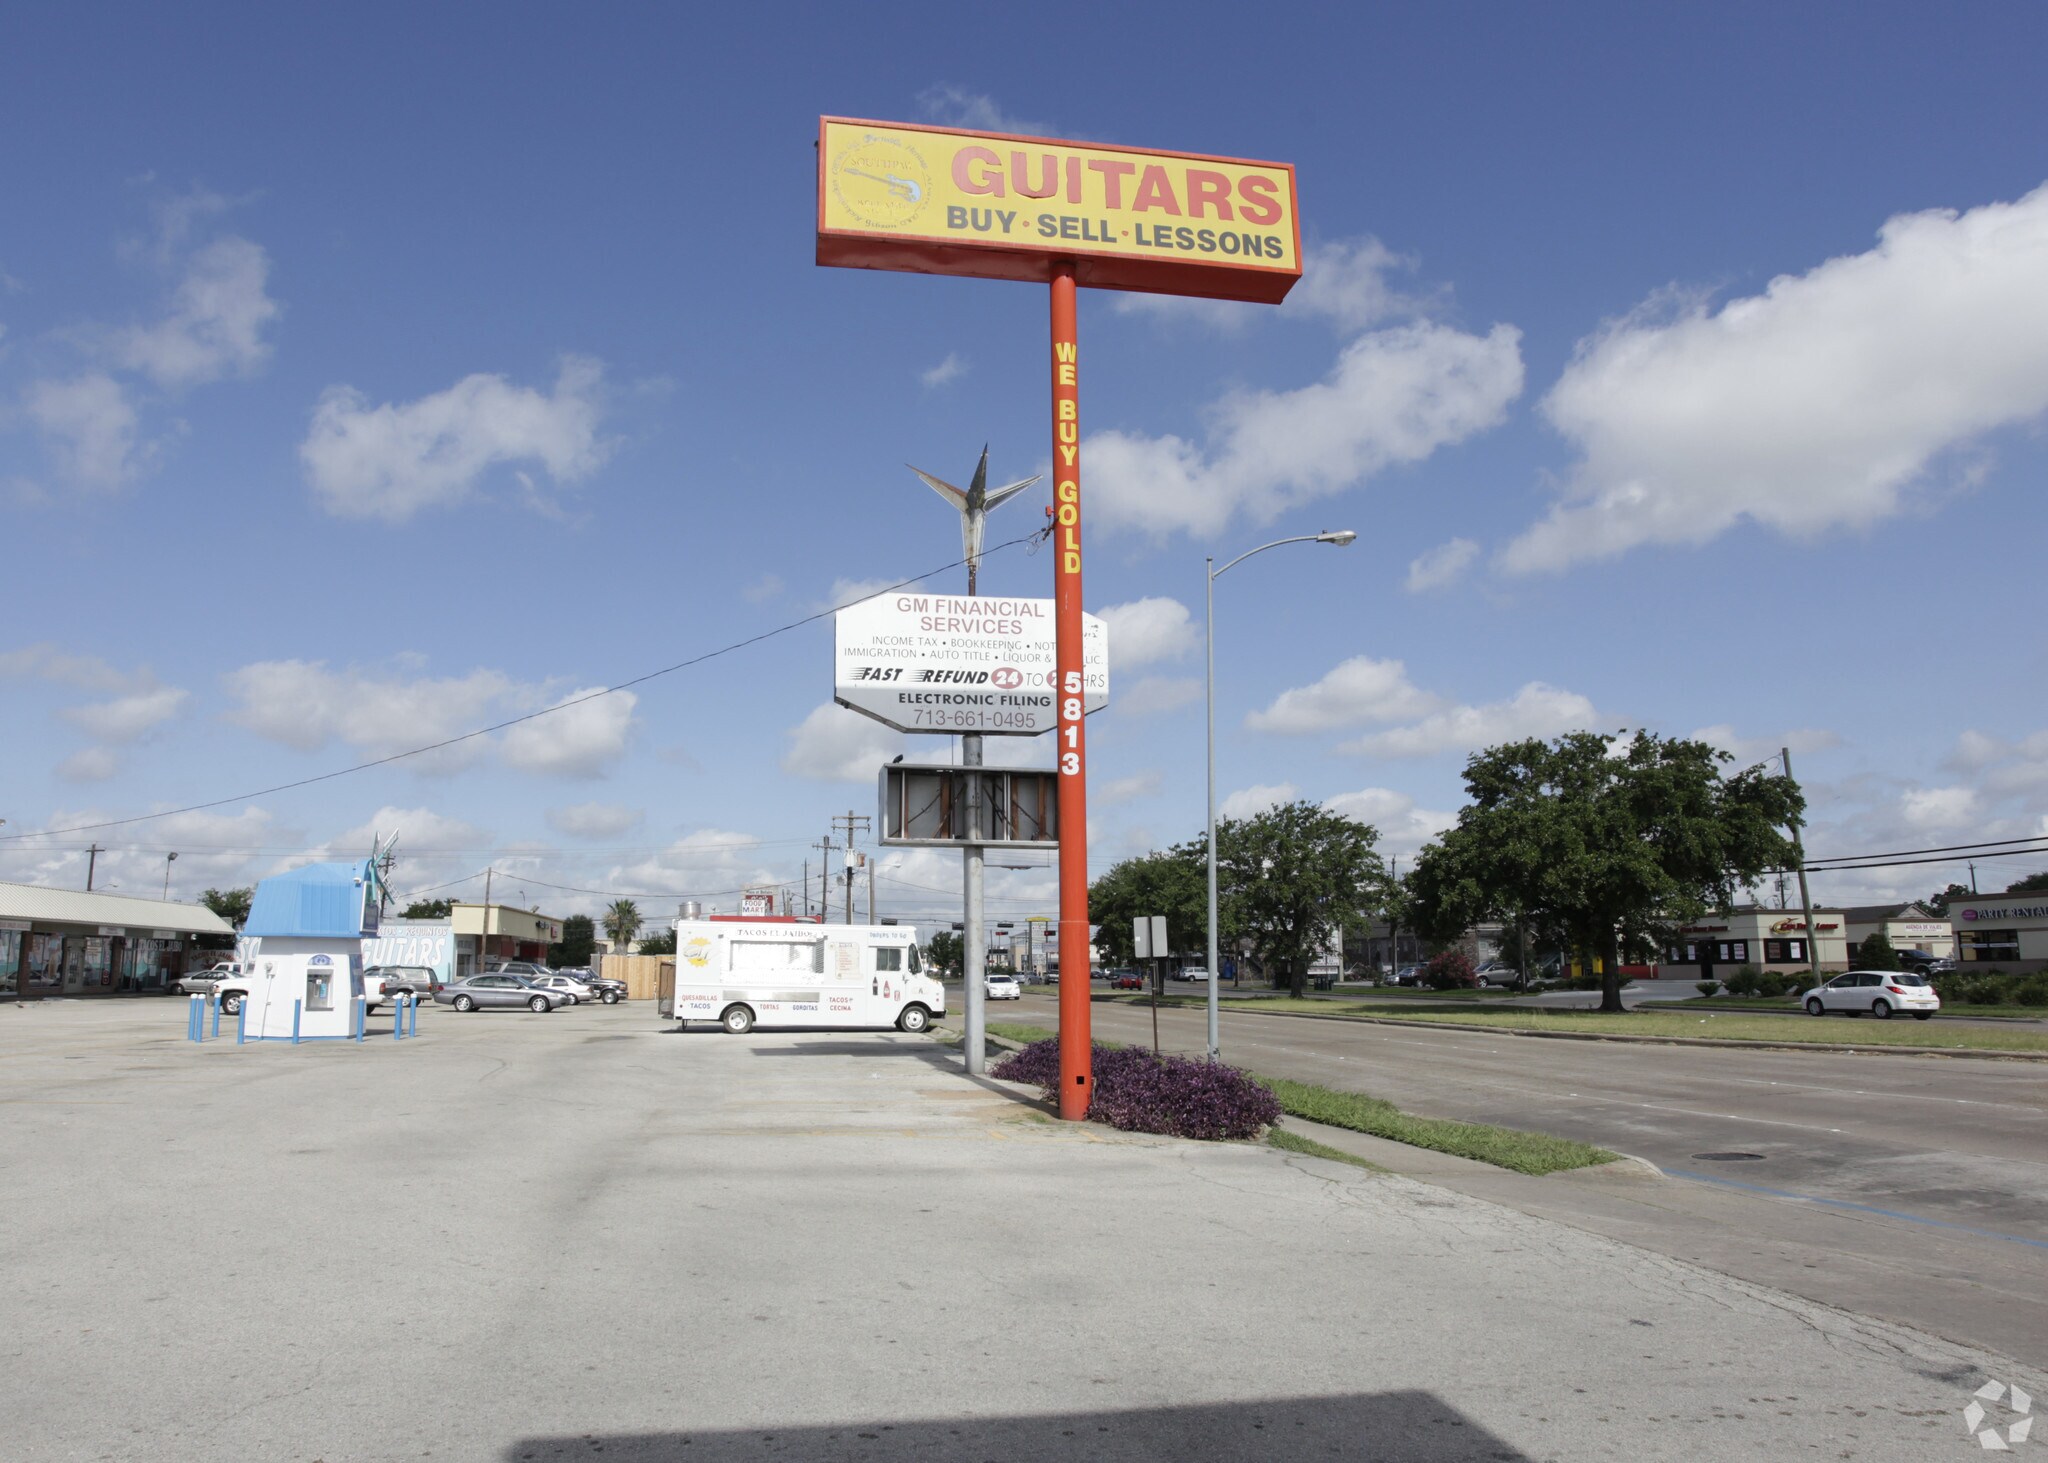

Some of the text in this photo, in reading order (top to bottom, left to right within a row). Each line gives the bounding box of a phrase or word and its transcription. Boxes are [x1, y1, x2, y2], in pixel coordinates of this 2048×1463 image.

[951, 145, 1283, 226] GUITARS
[946, 205, 1017, 234] BUY
[1037, 213, 1118, 244] SELL
[1134, 222, 1284, 260] LESSONS
[1055, 342, 1081, 574] WE BUY GOLD
[896, 597, 1046, 618] GM FINANCIAL
[920, 615, 1023, 635] SERVICES
[871, 635, 915, 647] INCOME
[918, 636, 938, 647] TAX
[951, 637, 1022, 650] BOOKKEEPING
[843, 647, 918, 659] IMMIGRATION
[929, 649, 960, 660] AUTO
[963, 650, 991, 661] TITLE
[1002, 651, 1041, 664] LIQUOR
[1044, 653, 1052, 663] &
[860, 667, 904, 681] FAST
[921, 669, 989, 685] REFUND
[994, 670, 1020, 686] 24
[1026, 672, 1044, 687] TO
[1083, 673, 1106, 688] HRS
[898, 692, 1052, 707] ELECTRONIC FILING
[913, 708, 1036, 729] 713-661-0495
[1061, 671, 1083, 777] 5813
[1977, 908, 2007, 920] PARTY
[361, 937, 446, 967] GUITARS
[681, 994, 718, 1002] QUESADILLAS
